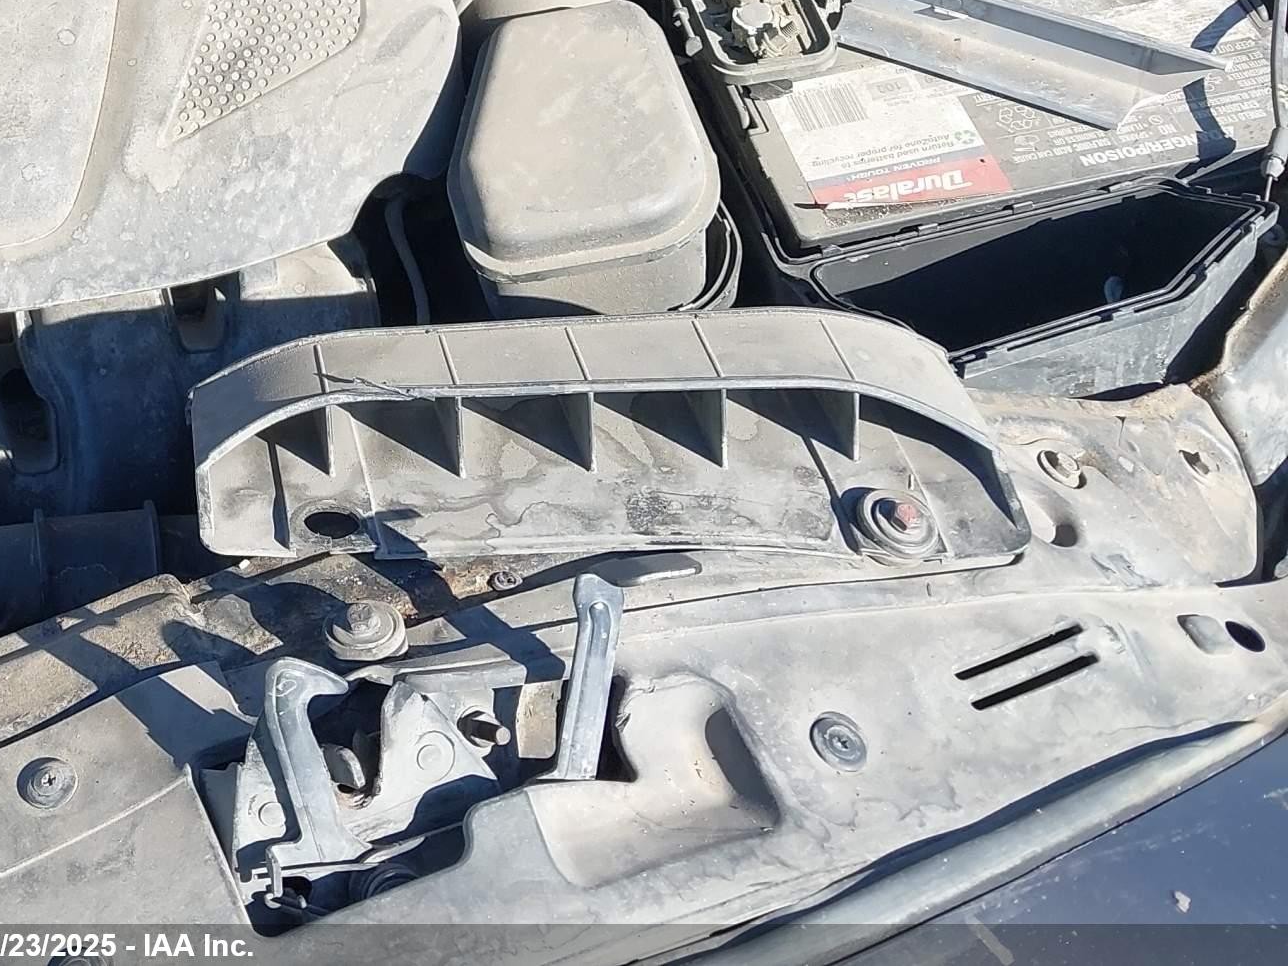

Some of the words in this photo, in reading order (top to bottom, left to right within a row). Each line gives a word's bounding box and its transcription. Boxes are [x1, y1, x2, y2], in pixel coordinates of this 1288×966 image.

[1158, 123, 1177, 135] NO
[904, 133, 951, 147] AutoZone
[921, 140, 955, 152] Return
[857, 145, 888, 159] proper
[889, 142, 903, 152] for
[897, 146, 919, 157] used
[854, 152, 896, 165] batteries
[893, 156, 941, 171] PROVEN
[840, 161, 851, 169] to
[843, 170, 973, 203] Duralast
